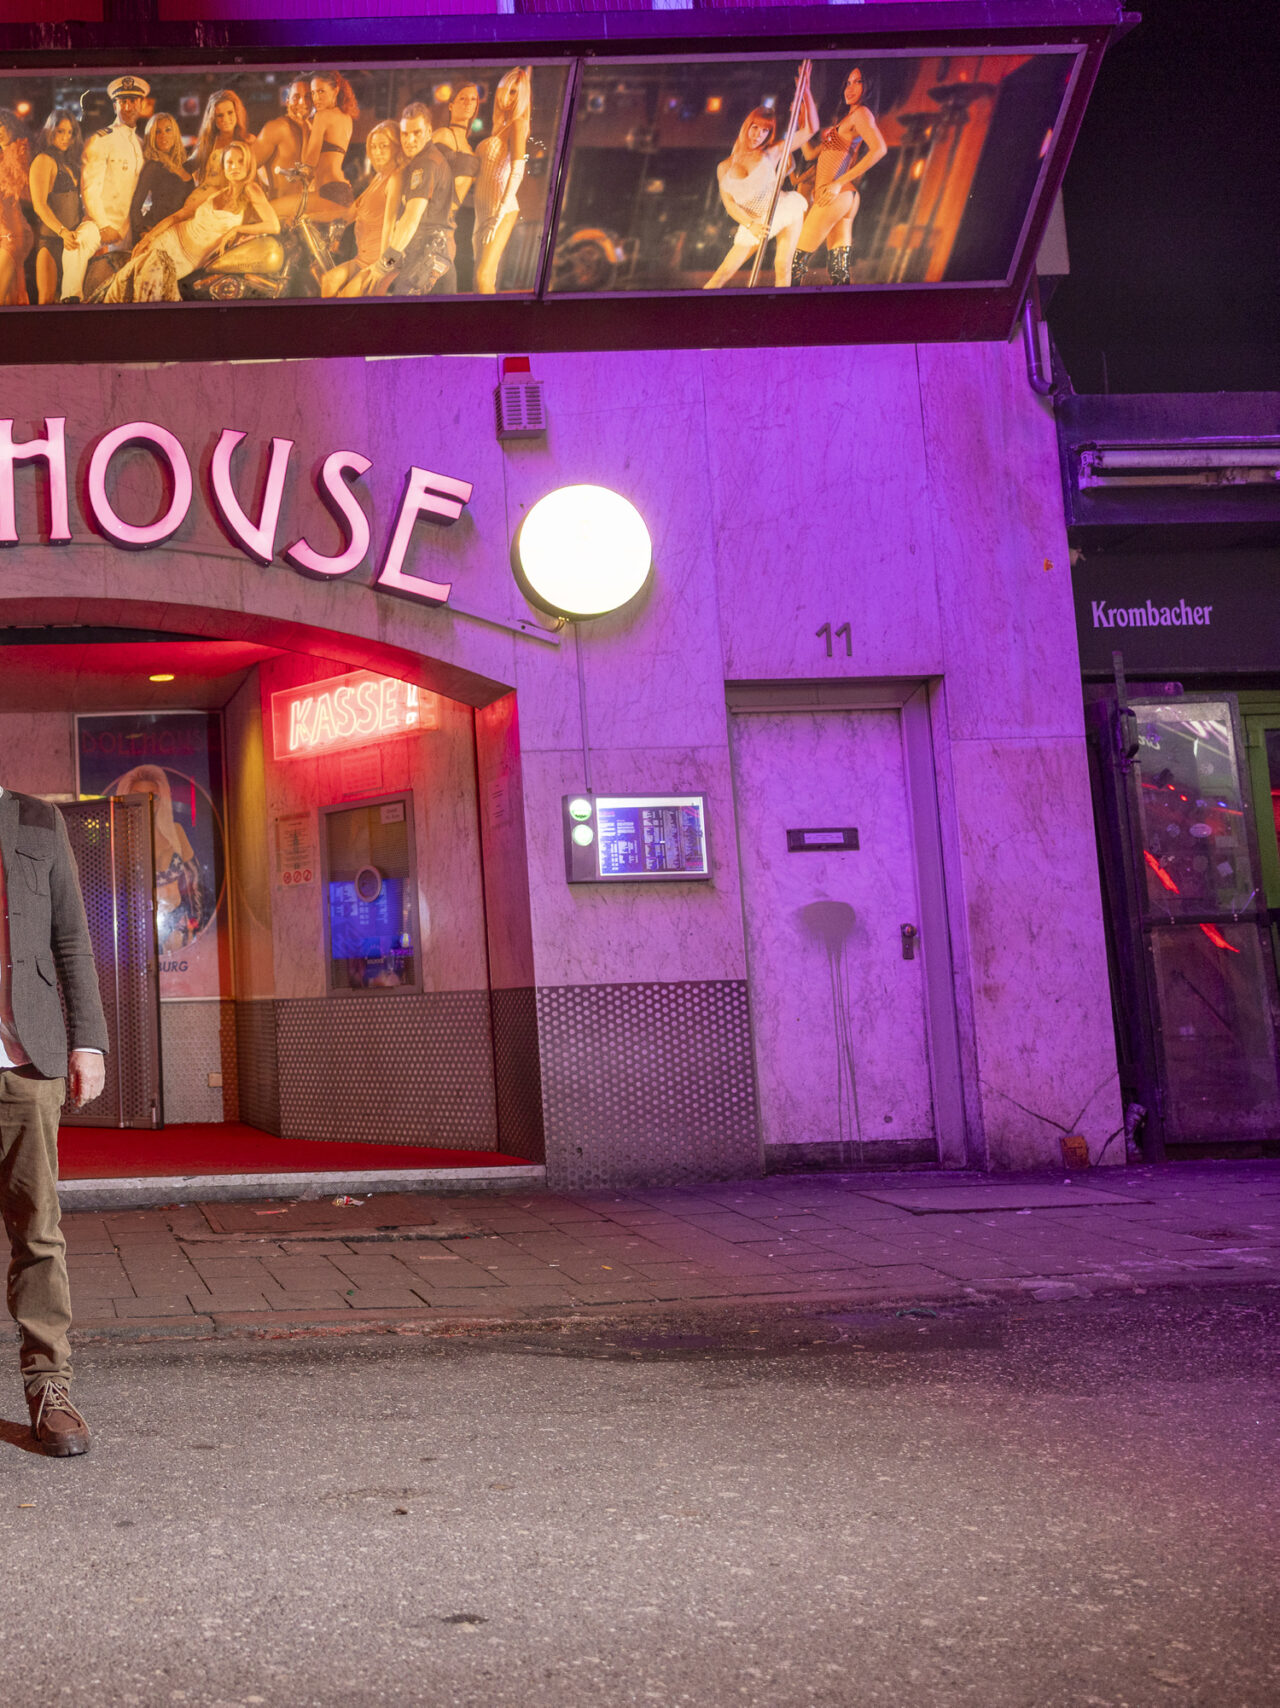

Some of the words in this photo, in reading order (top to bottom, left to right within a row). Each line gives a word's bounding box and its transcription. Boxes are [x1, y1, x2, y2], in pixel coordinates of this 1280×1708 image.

[1091, 599, 1213, 628] Krombacher
[815, 622, 853, 657] 11
[290, 677, 419, 751] KASSE!
